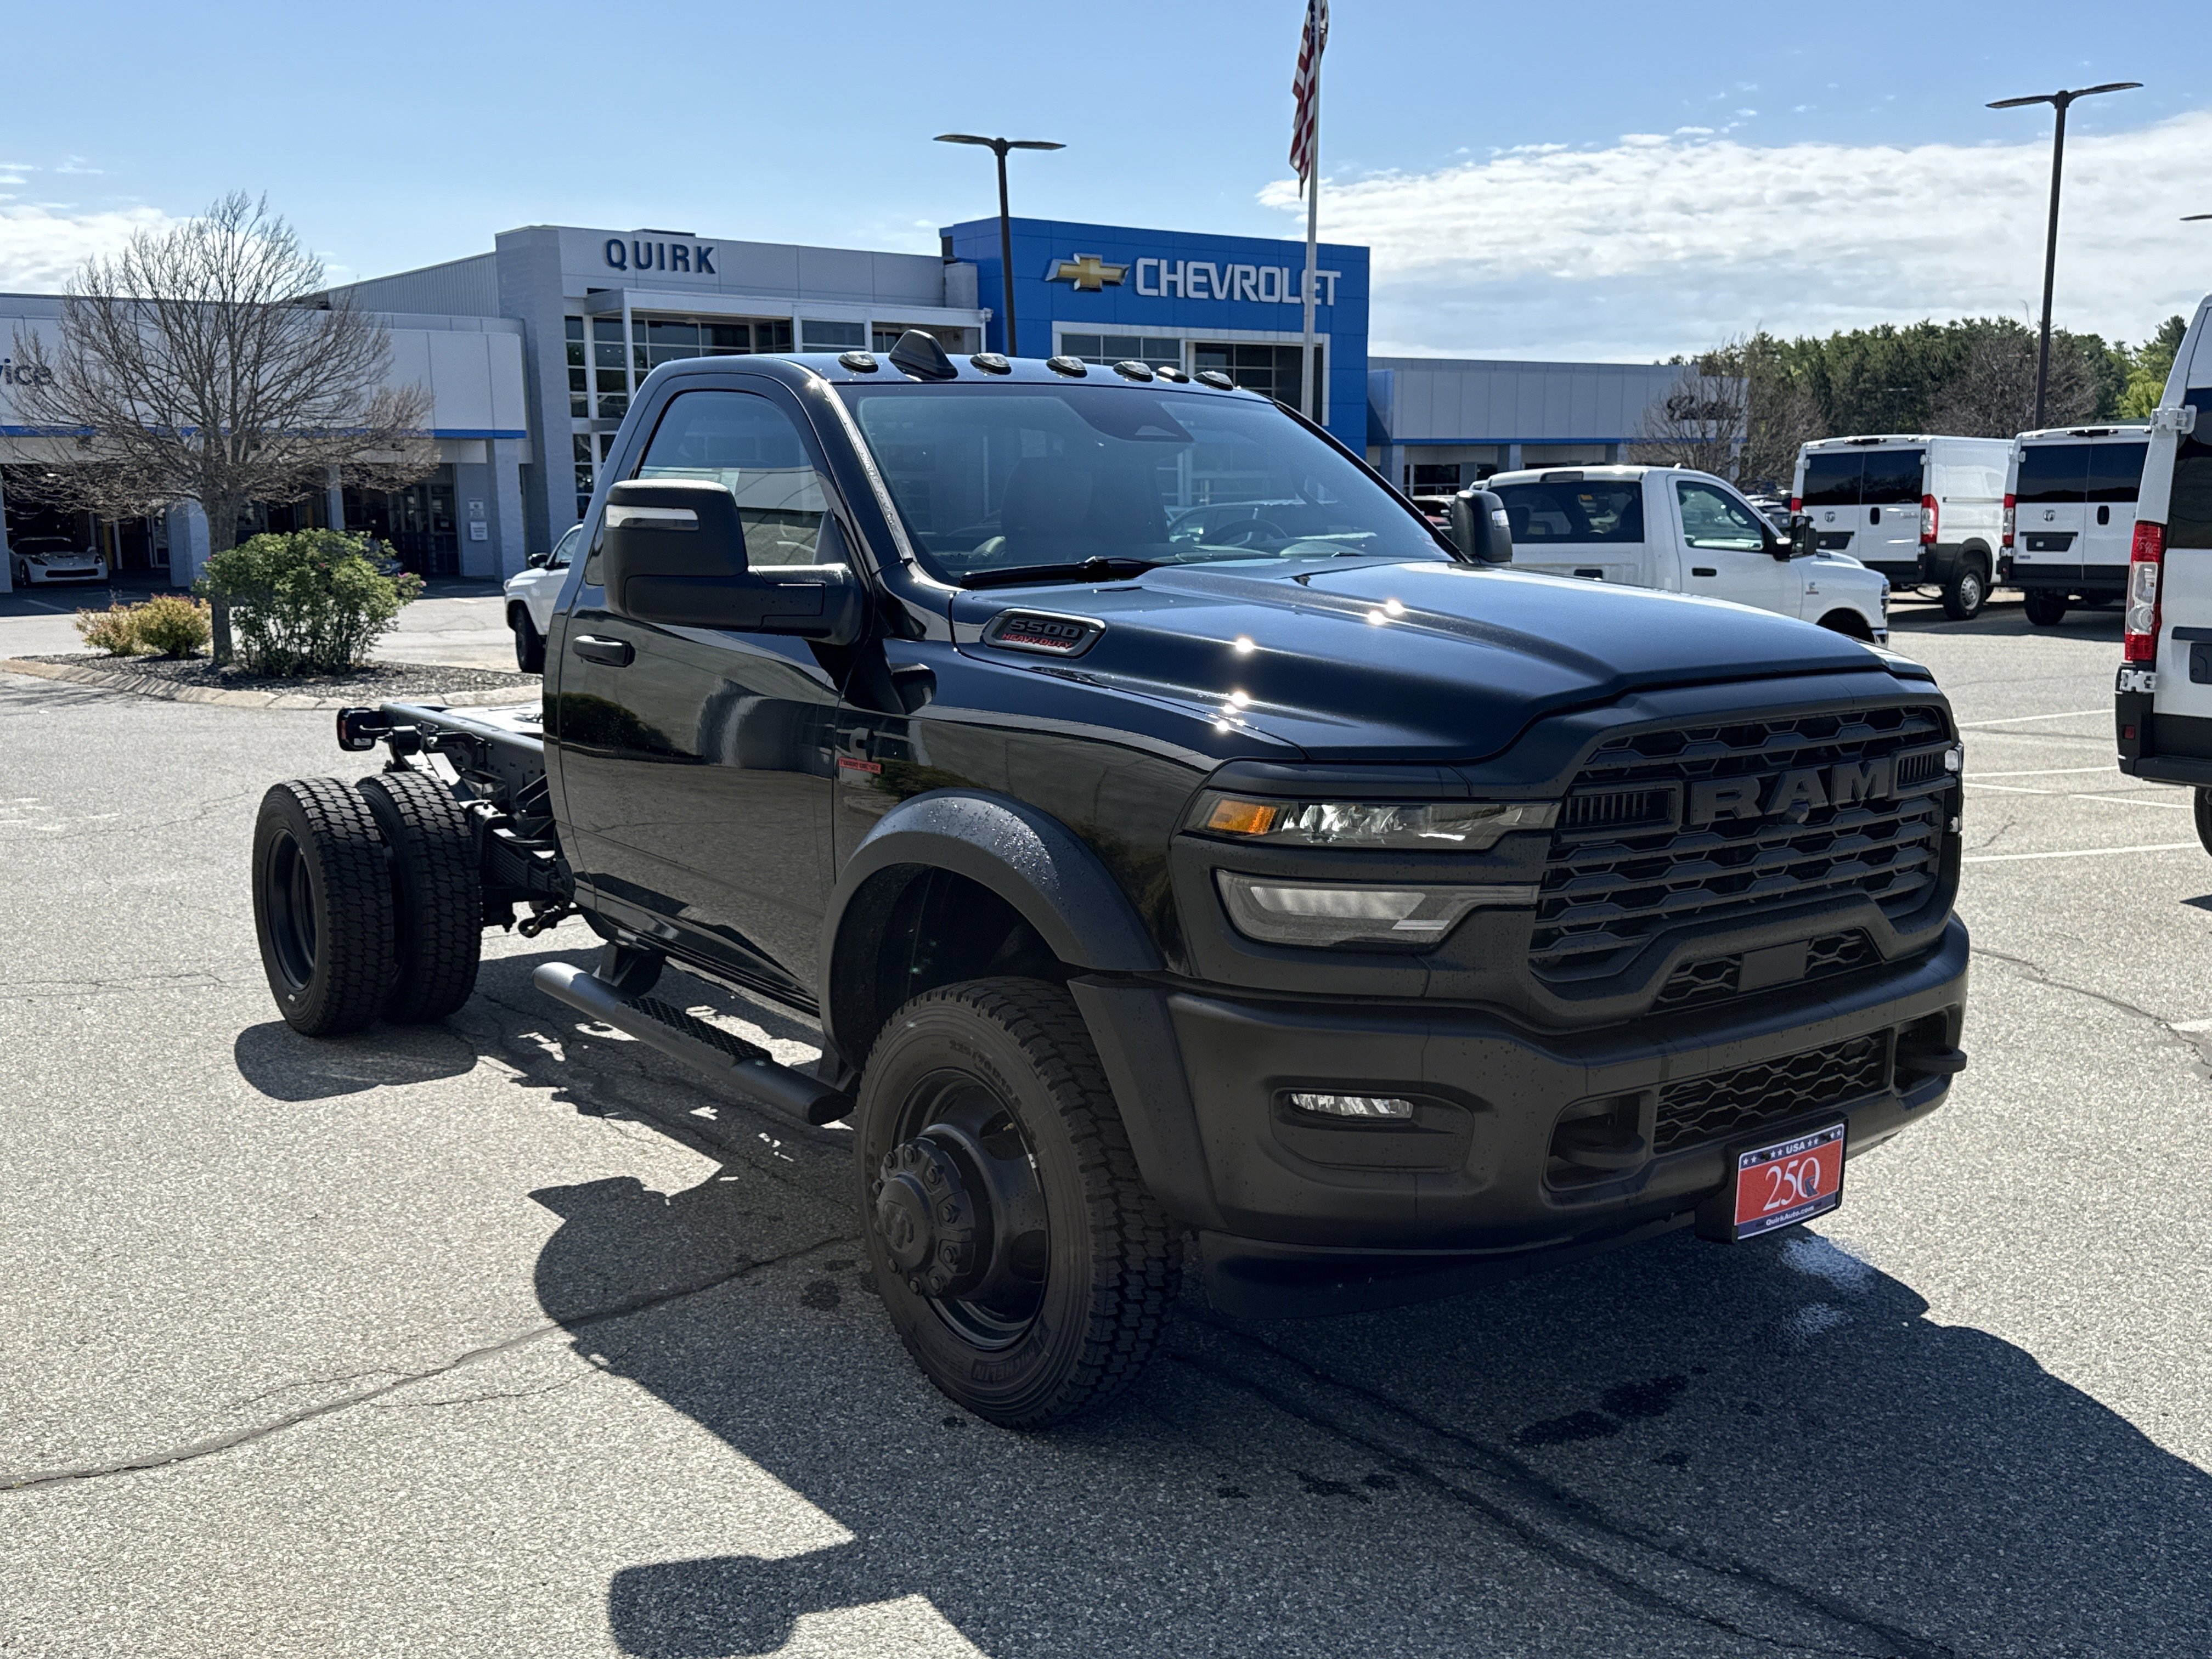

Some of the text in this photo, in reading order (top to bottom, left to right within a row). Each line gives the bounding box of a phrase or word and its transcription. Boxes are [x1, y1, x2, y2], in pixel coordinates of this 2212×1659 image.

[606, 239, 715, 274] QUIRK
[0, 358, 52, 385] ice
[1010, 619, 1080, 639] 5500
[1002, 633, 1073, 650] HEAVY DUTY
[1690, 758, 1890, 825] RAM
[1785, 1142, 1805, 1154] USA
[1763, 1157, 1820, 1211] 250
[1765, 1205, 1814, 1226] QuirkAuto.com
